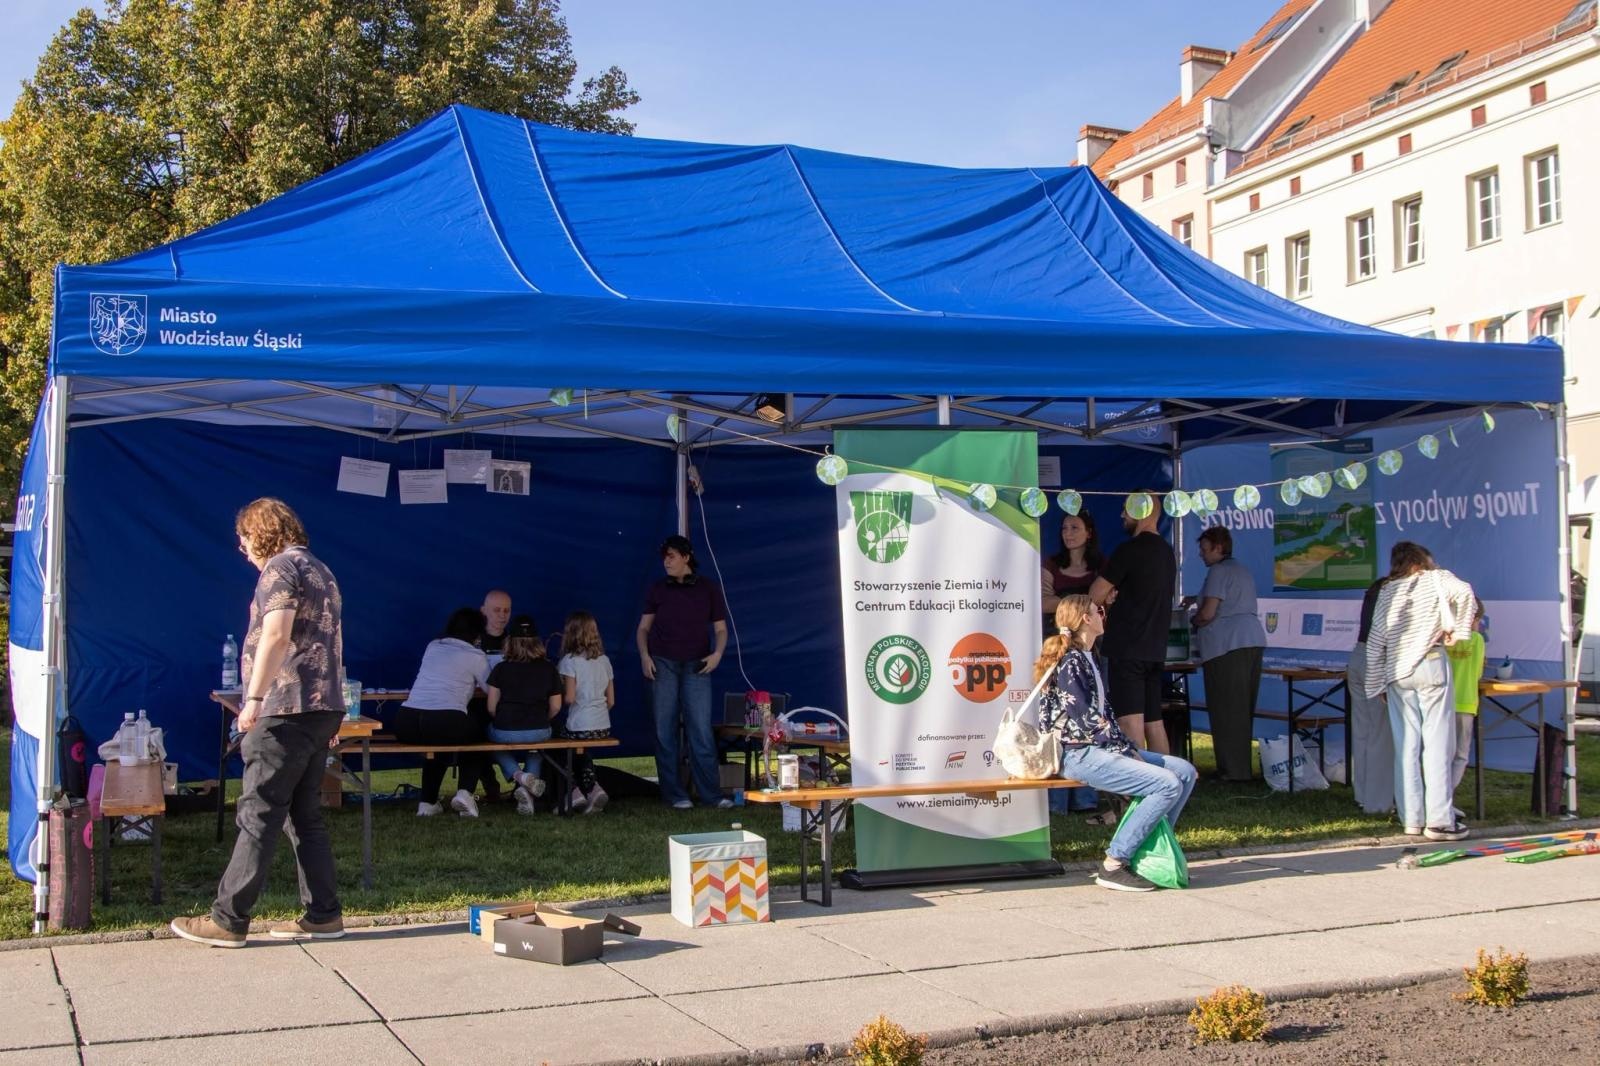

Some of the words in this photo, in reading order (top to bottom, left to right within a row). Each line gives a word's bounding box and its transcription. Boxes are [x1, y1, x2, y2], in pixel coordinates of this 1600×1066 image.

[159, 307, 217, 325] Miasto
[159, 328, 249, 349] Wodzisław
[252, 328, 303, 352] Śląski
[853, 580, 942, 594] Stowarzyszenie
[944, 579, 983, 591] Ziemia
[985, 580, 989, 590] i
[991, 579, 1008, 593] My
[855, 600, 906, 612] Centrum
[909, 600, 956, 613] Edukacji
[958, 600, 1025, 613] Ekologicznej
[866, 649, 881, 692] MECENAS
[877, 637, 919, 651] POLSKIEJ
[950, 664, 1006, 692] opp
[917, 734, 967, 742] dofinansowane
[1271, 754, 1307, 775] ACTON
